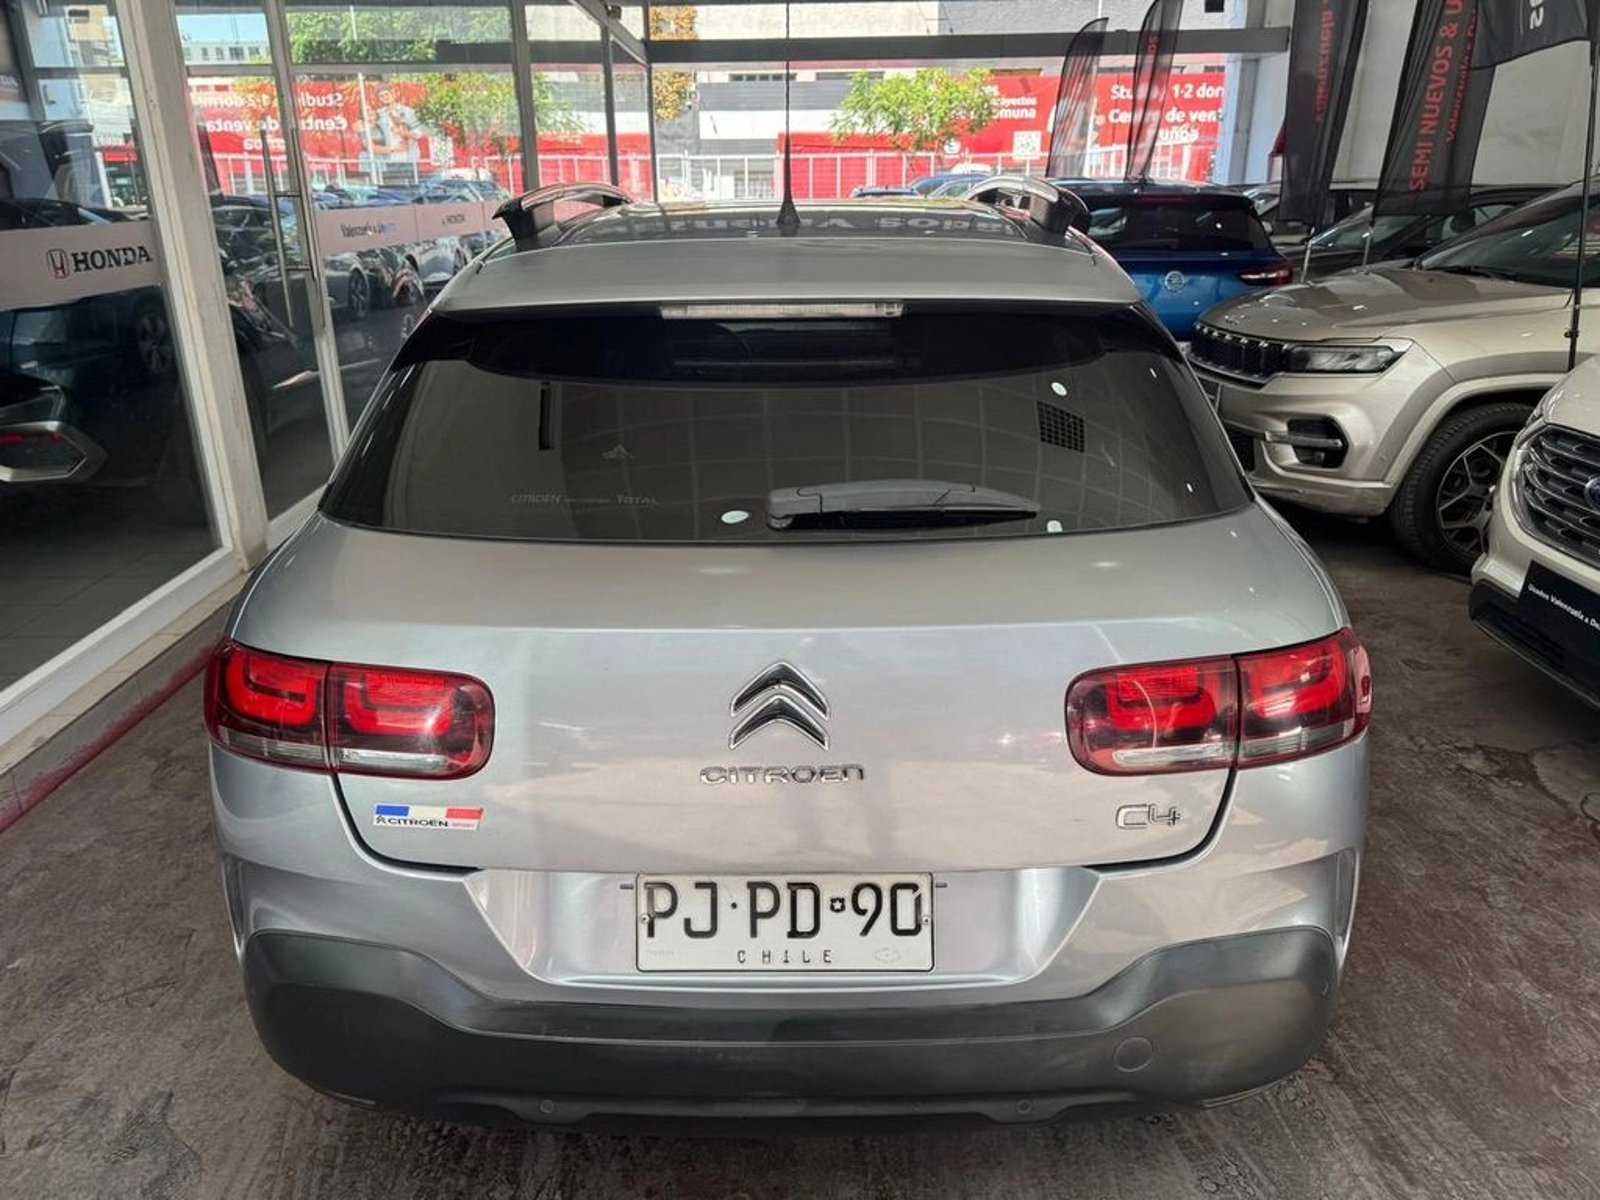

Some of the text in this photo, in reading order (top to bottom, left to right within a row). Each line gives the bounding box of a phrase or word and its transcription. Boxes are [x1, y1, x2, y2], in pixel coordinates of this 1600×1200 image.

[1419, 46, 1453, 134] NUEVOS
[1165, 106, 1186, 122] de
[1409, 142, 1433, 190] SEMI
[71, 245, 153, 272] HONDA
[736, 949, 833, 964] CHILE
